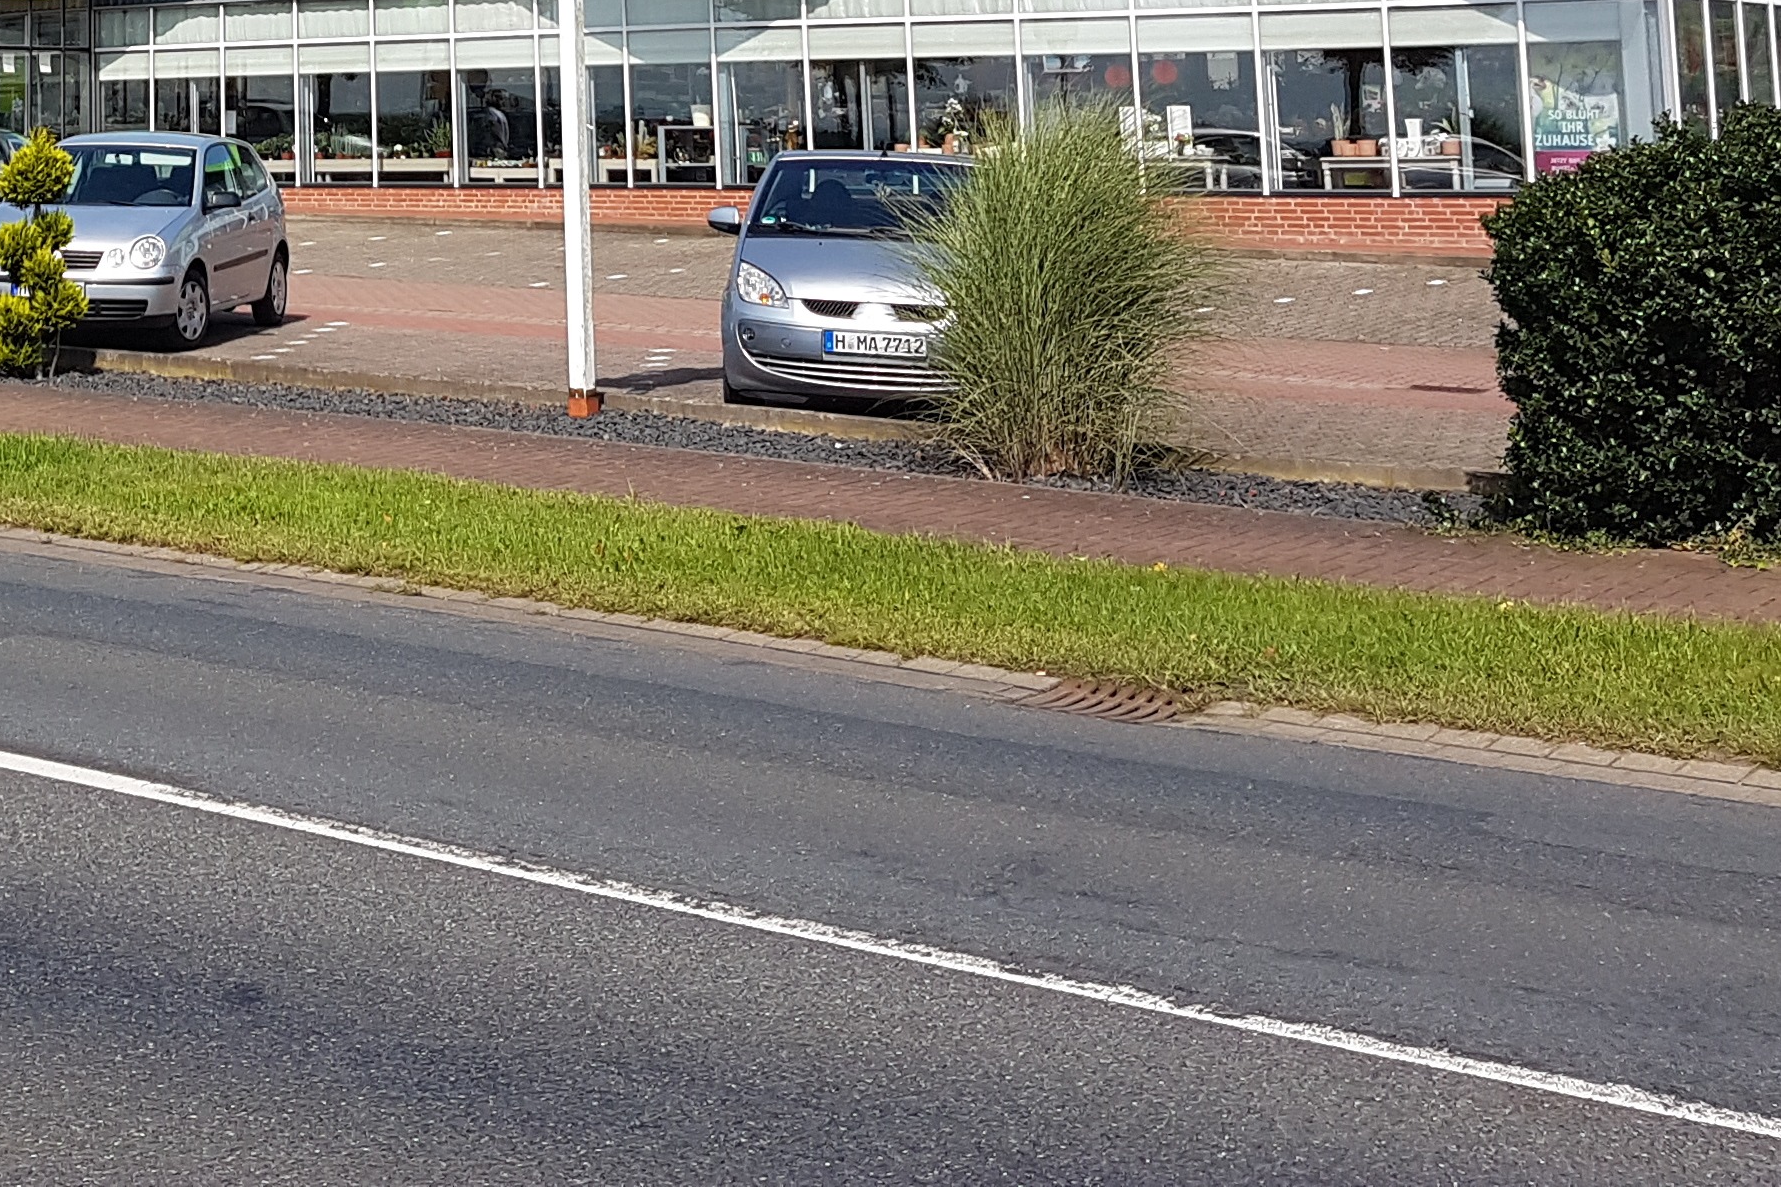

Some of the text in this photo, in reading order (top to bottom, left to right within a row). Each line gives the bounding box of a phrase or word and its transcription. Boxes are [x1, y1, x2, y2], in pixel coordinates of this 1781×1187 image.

[1548, 109, 1562, 120] SO
[1561, 121, 1584, 133] IHR
[1534, 134, 1595, 147] ZUHAUSE
[834, 334, 925, 355] H MA 7712
